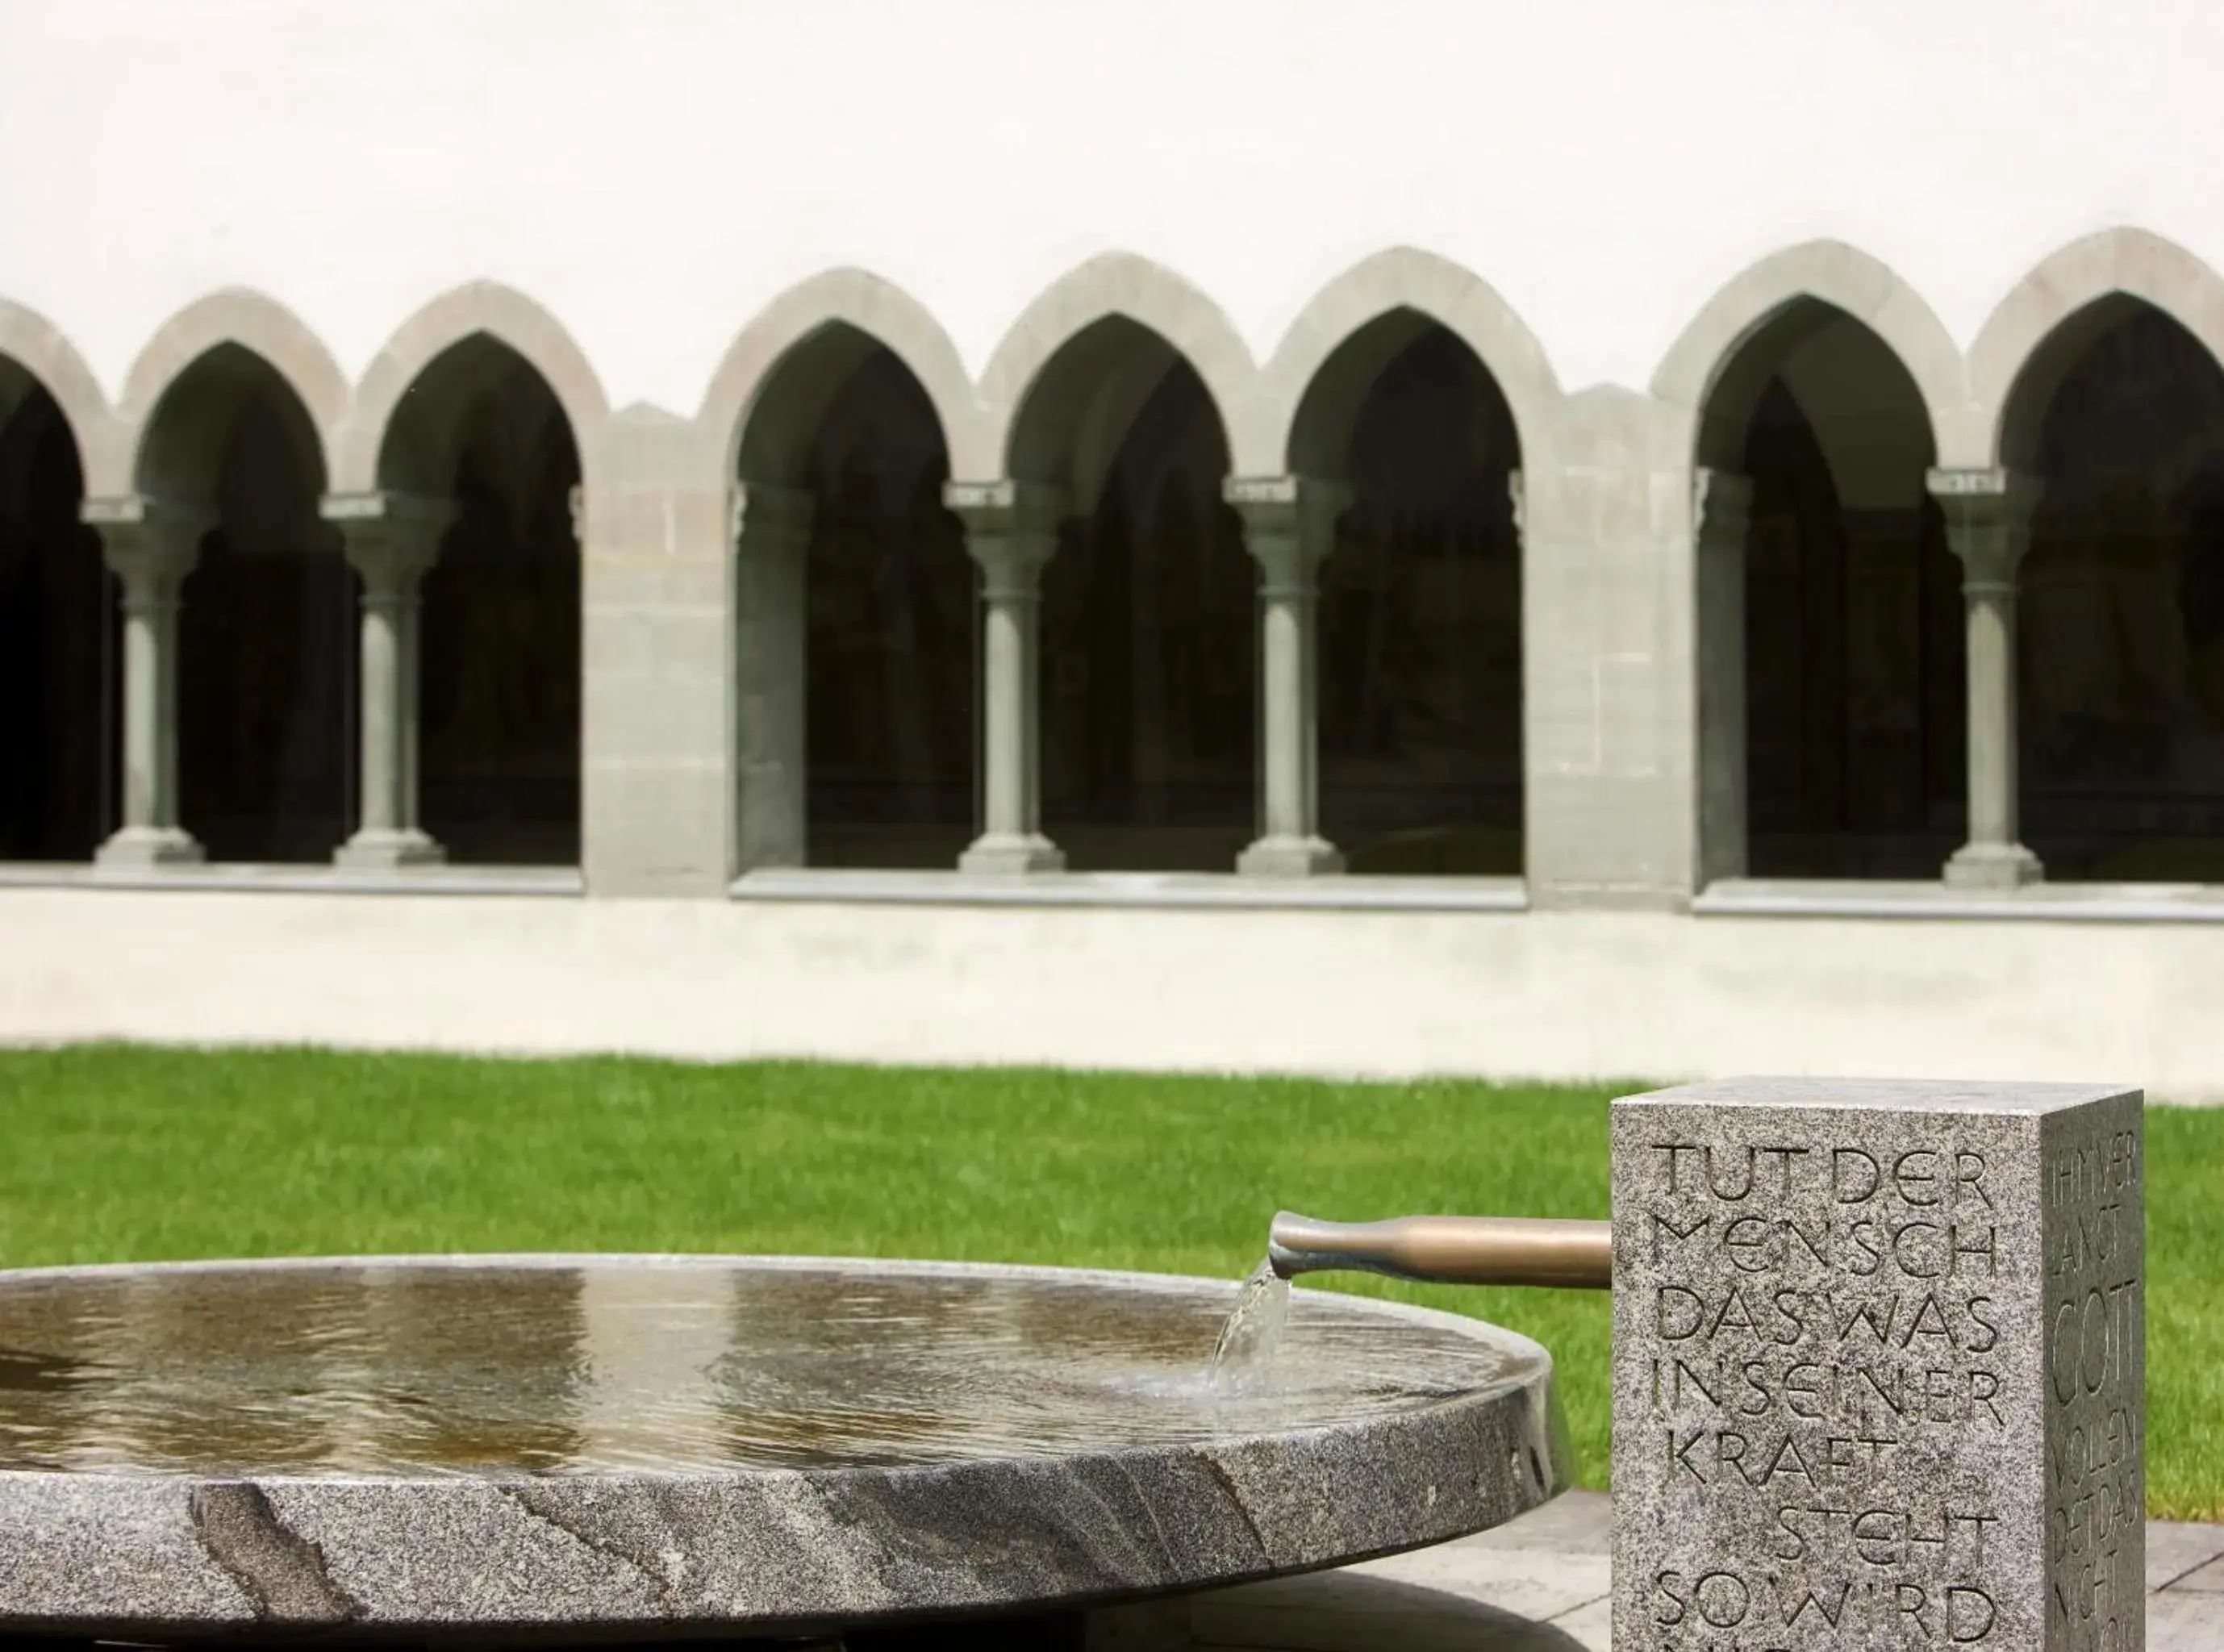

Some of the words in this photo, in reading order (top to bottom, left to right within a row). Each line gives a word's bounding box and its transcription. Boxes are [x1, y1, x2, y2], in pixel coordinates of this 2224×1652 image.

[1651, 1144, 1809, 1201] TUT
[1832, 1148, 1994, 1208] DER
[1650, 1210, 1998, 1279] MENSCH
[1656, 1287, 1803, 1346] DAS
[1825, 1289, 1998, 1354] WAS
[2051, 1277, 2138, 1410] GOTT
[1667, 1430, 1898, 1488] KRAFT
[1775, 1505, 1999, 1569] STEHT
[1656, 1571, 1750, 1629] SO
[1769, 1576, 1997, 1642] WIRD
